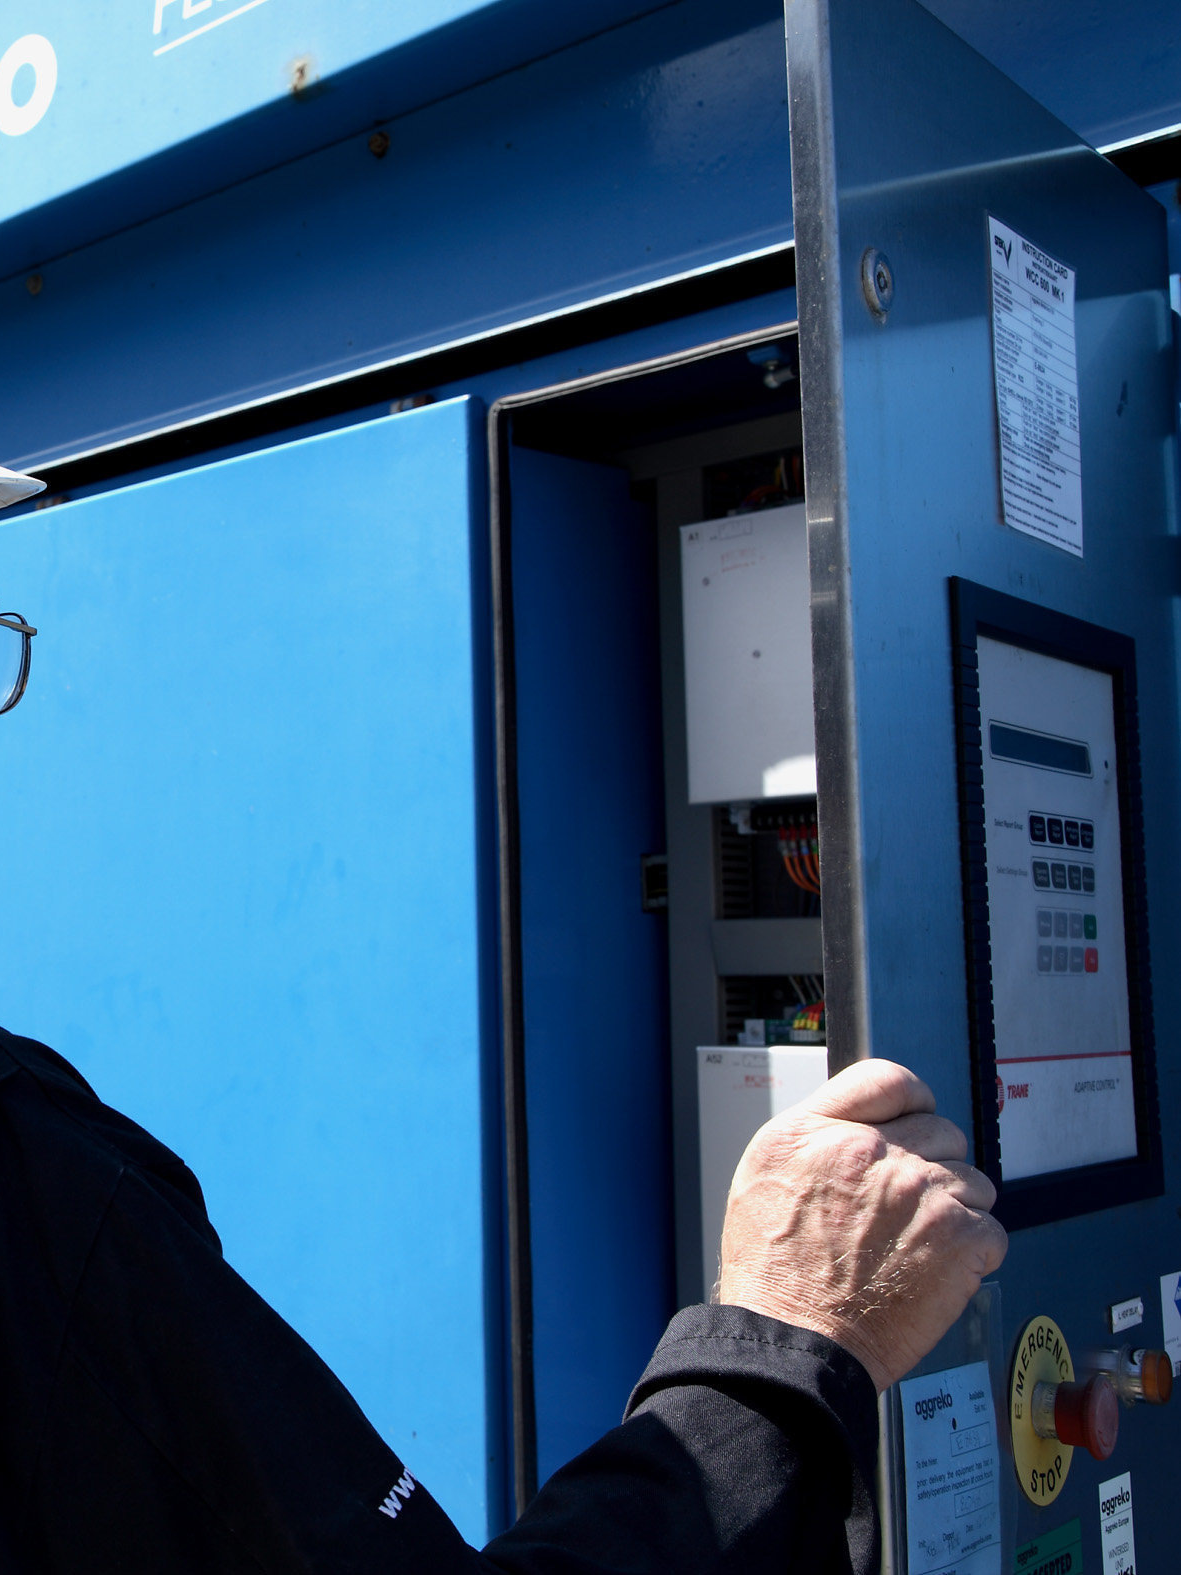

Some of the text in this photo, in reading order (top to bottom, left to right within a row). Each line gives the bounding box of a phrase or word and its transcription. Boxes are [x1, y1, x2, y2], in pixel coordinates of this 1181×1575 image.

[1053, 262, 1068, 280] CARD
[1007, 1083, 1029, 1100] TRANE
[1015, 1325, 1069, 1420] EMERGENC
[915, 1388, 953, 1420] aggreko
[1030, 1454, 1063, 1497] STOP
[378, 1466, 417, 1519] ww
[1101, 1486, 1131, 1516] aggreko
